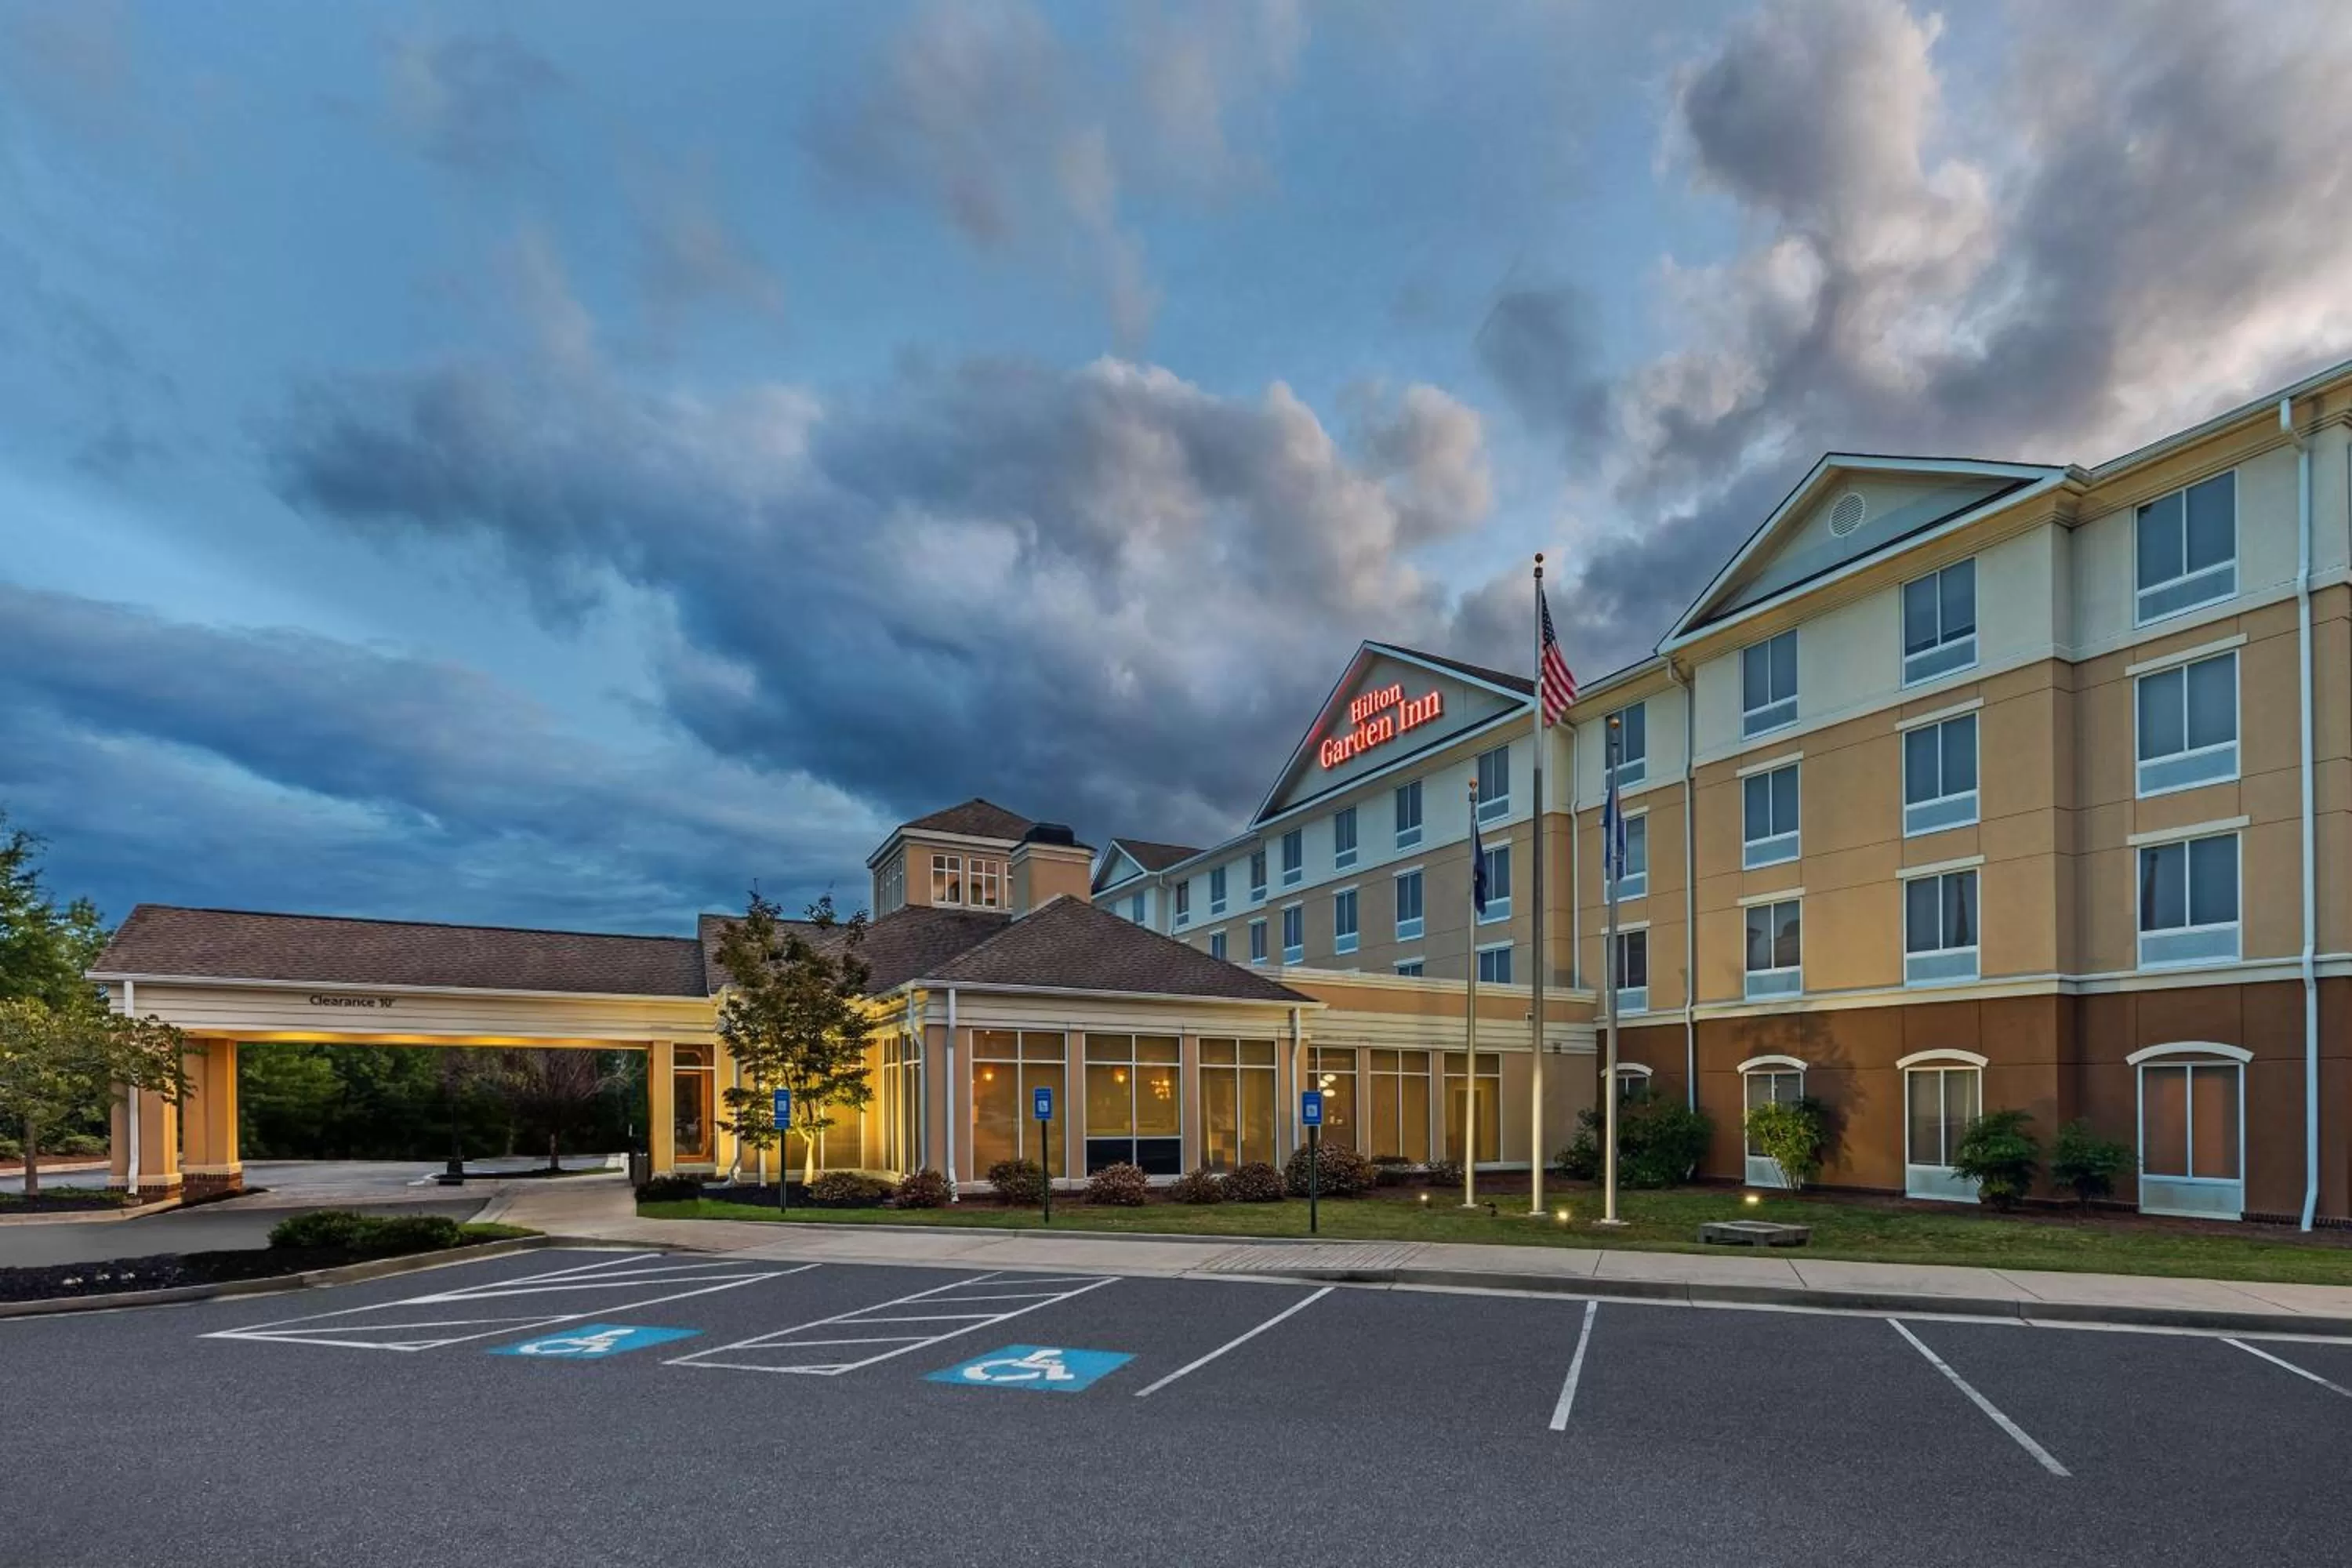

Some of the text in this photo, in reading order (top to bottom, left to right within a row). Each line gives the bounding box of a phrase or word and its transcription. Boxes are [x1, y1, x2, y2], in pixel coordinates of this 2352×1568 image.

[1350, 683, 1402, 724] Hilton
[1320, 691, 1442, 768] Garden Inn
[309, 994, 376, 1007] Clearance
